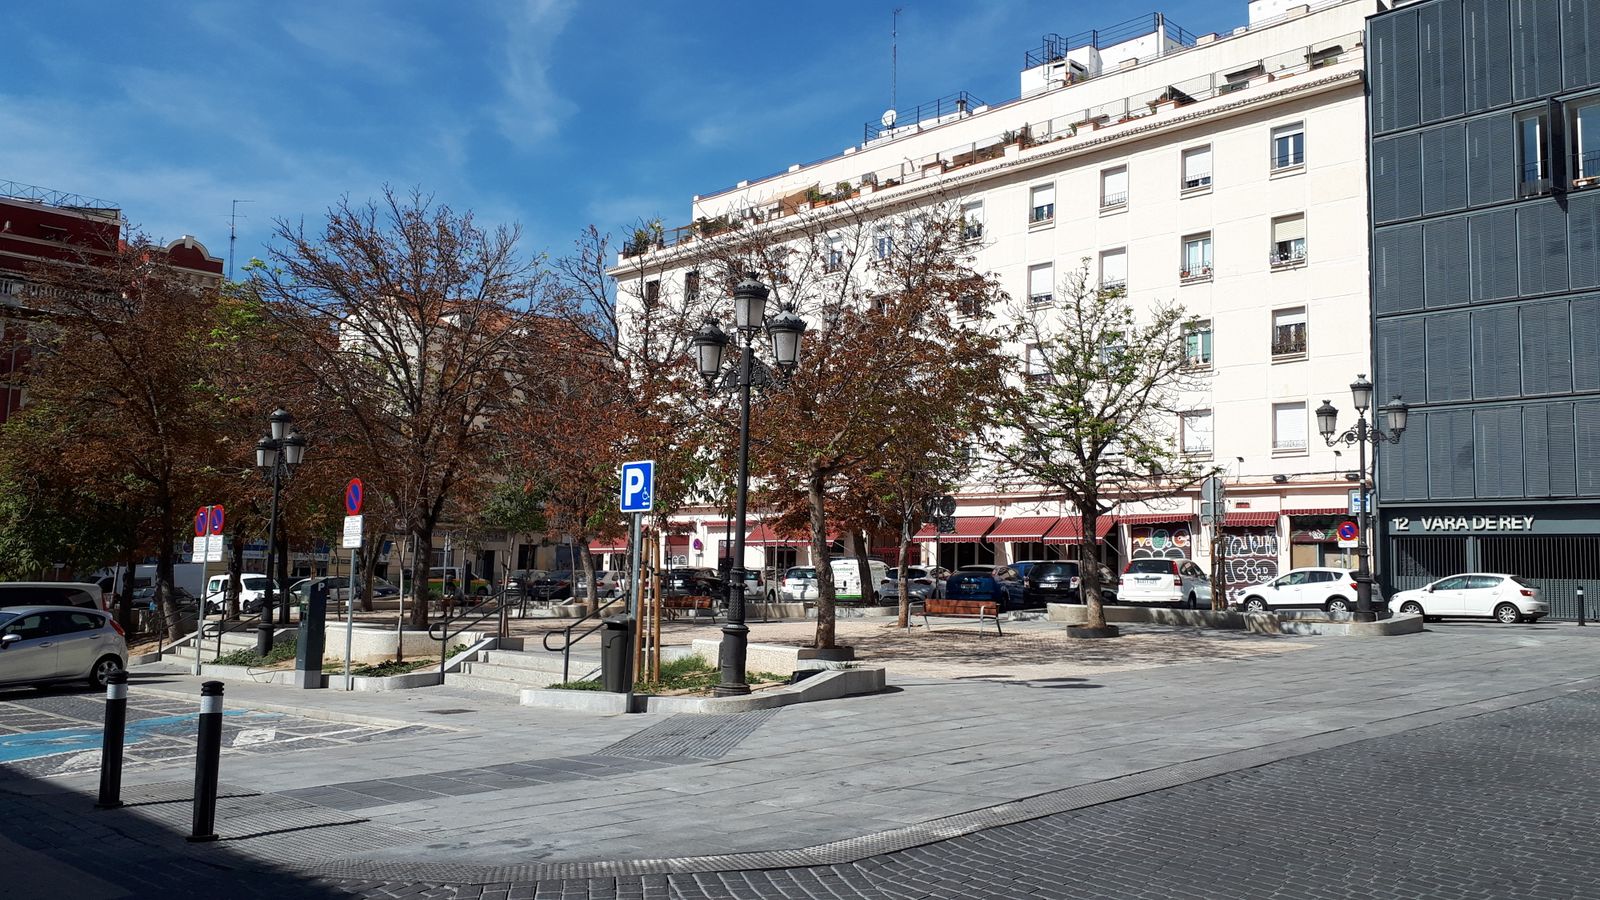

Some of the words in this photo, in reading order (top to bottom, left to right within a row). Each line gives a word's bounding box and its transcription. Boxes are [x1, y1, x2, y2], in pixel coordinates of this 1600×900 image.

[625, 468, 644, 506] P
[1392, 516, 1409, 530] 12
[1420, 515, 1469, 530] VARA
[1472, 515, 1497, 530] DE
[1499, 515, 1534, 530] REY
[318, 582, 326, 591] P
